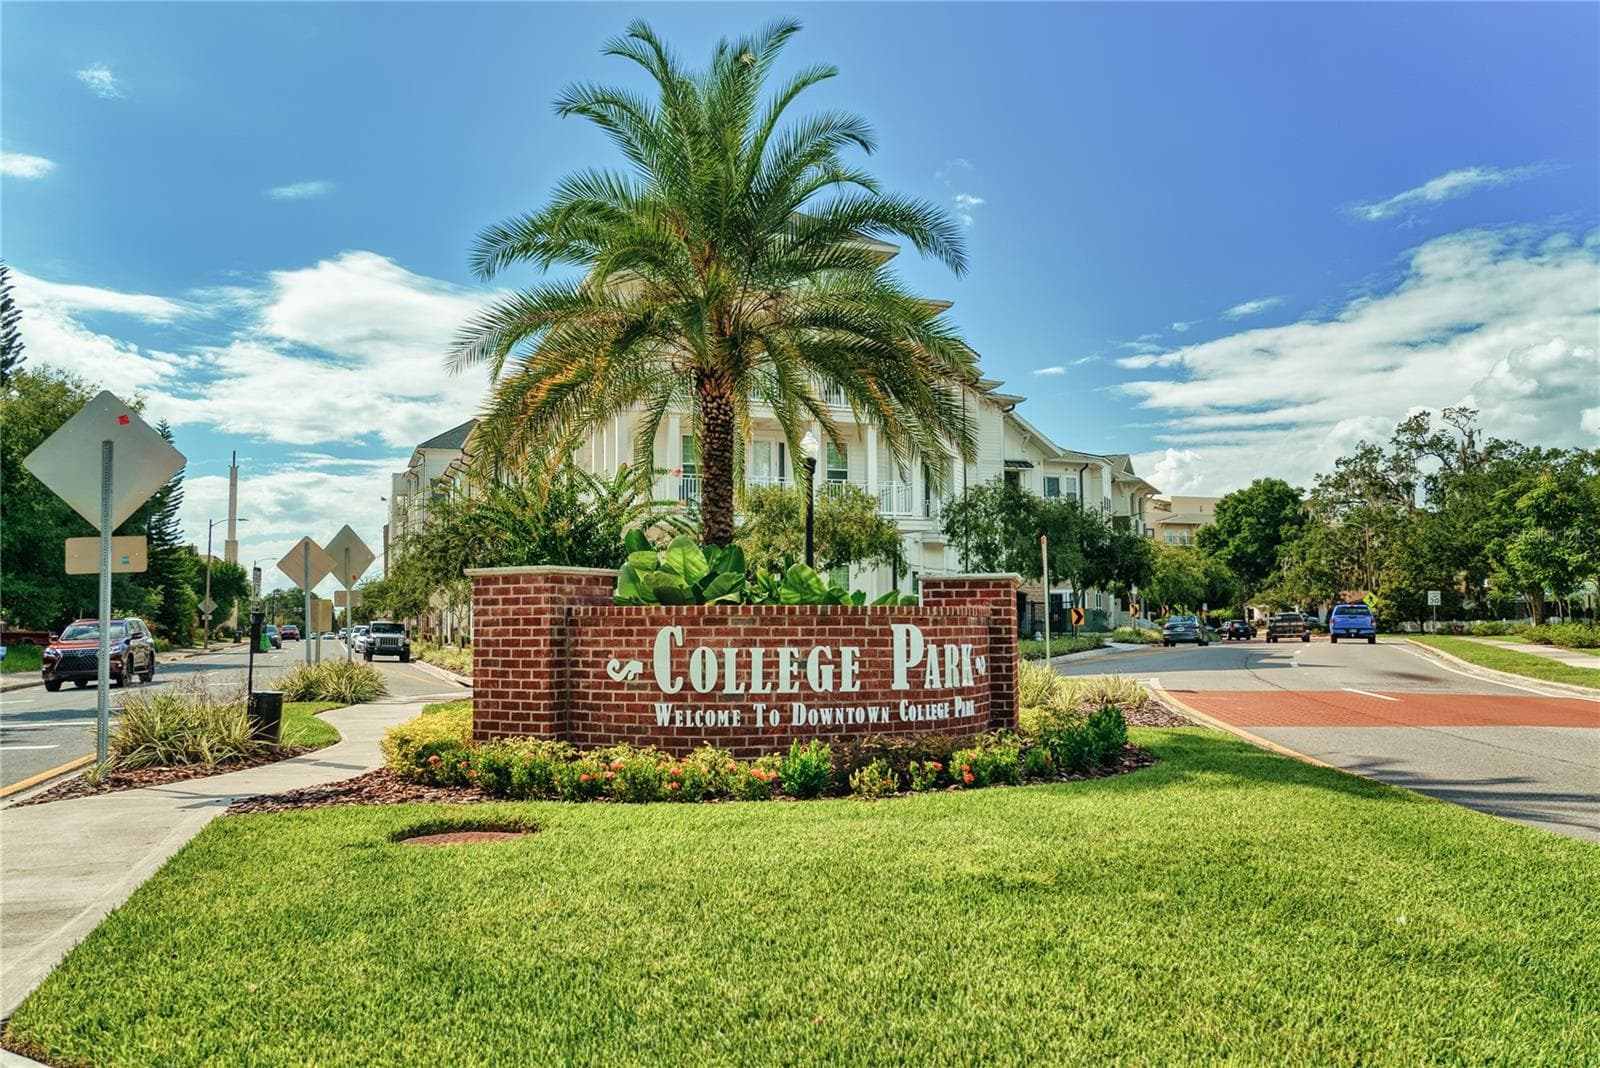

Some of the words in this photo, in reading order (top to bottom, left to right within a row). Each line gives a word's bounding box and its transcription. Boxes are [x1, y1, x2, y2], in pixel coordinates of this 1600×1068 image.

[653, 625, 861, 694] COLLEGE
[891, 623, 974, 690] PARK
[654, 703, 741, 727] WELCOME
[753, 703, 780, 727] TO
[792, 701, 890, 727] DOWNTOWN
[899, 699, 949, 722] COLLEGE
[954, 696, 975, 717] PARK
